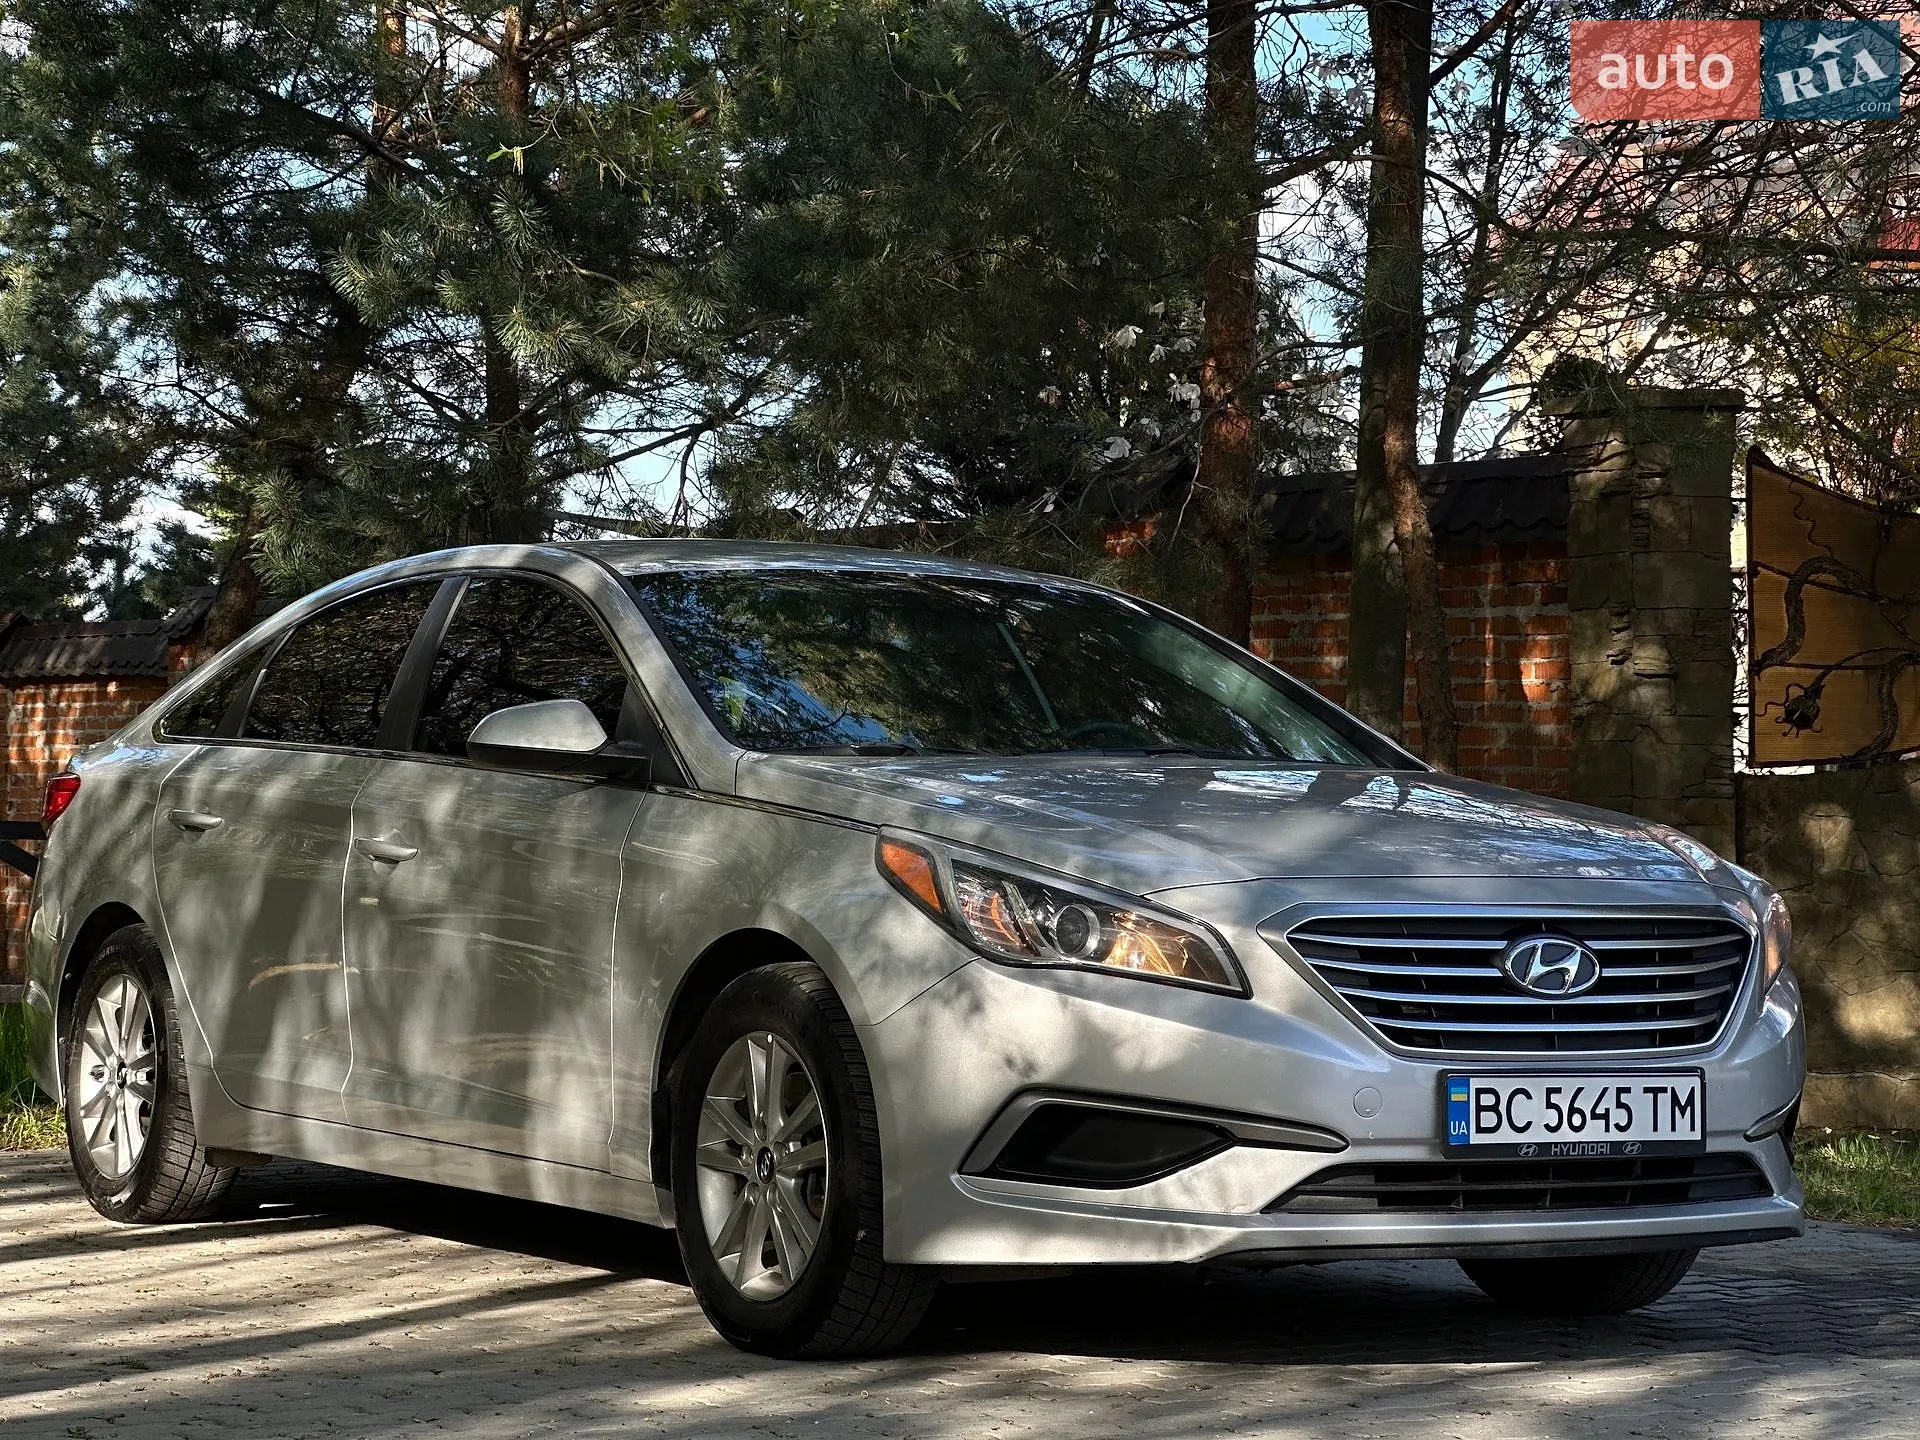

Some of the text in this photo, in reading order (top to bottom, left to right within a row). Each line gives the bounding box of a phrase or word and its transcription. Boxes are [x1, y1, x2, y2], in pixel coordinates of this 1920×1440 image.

[1474, 1086, 1696, 1134] BC 5645 TM
[1450, 1122, 1468, 1135] UA
[1551, 1143, 1610, 1156] HYUNDAI
